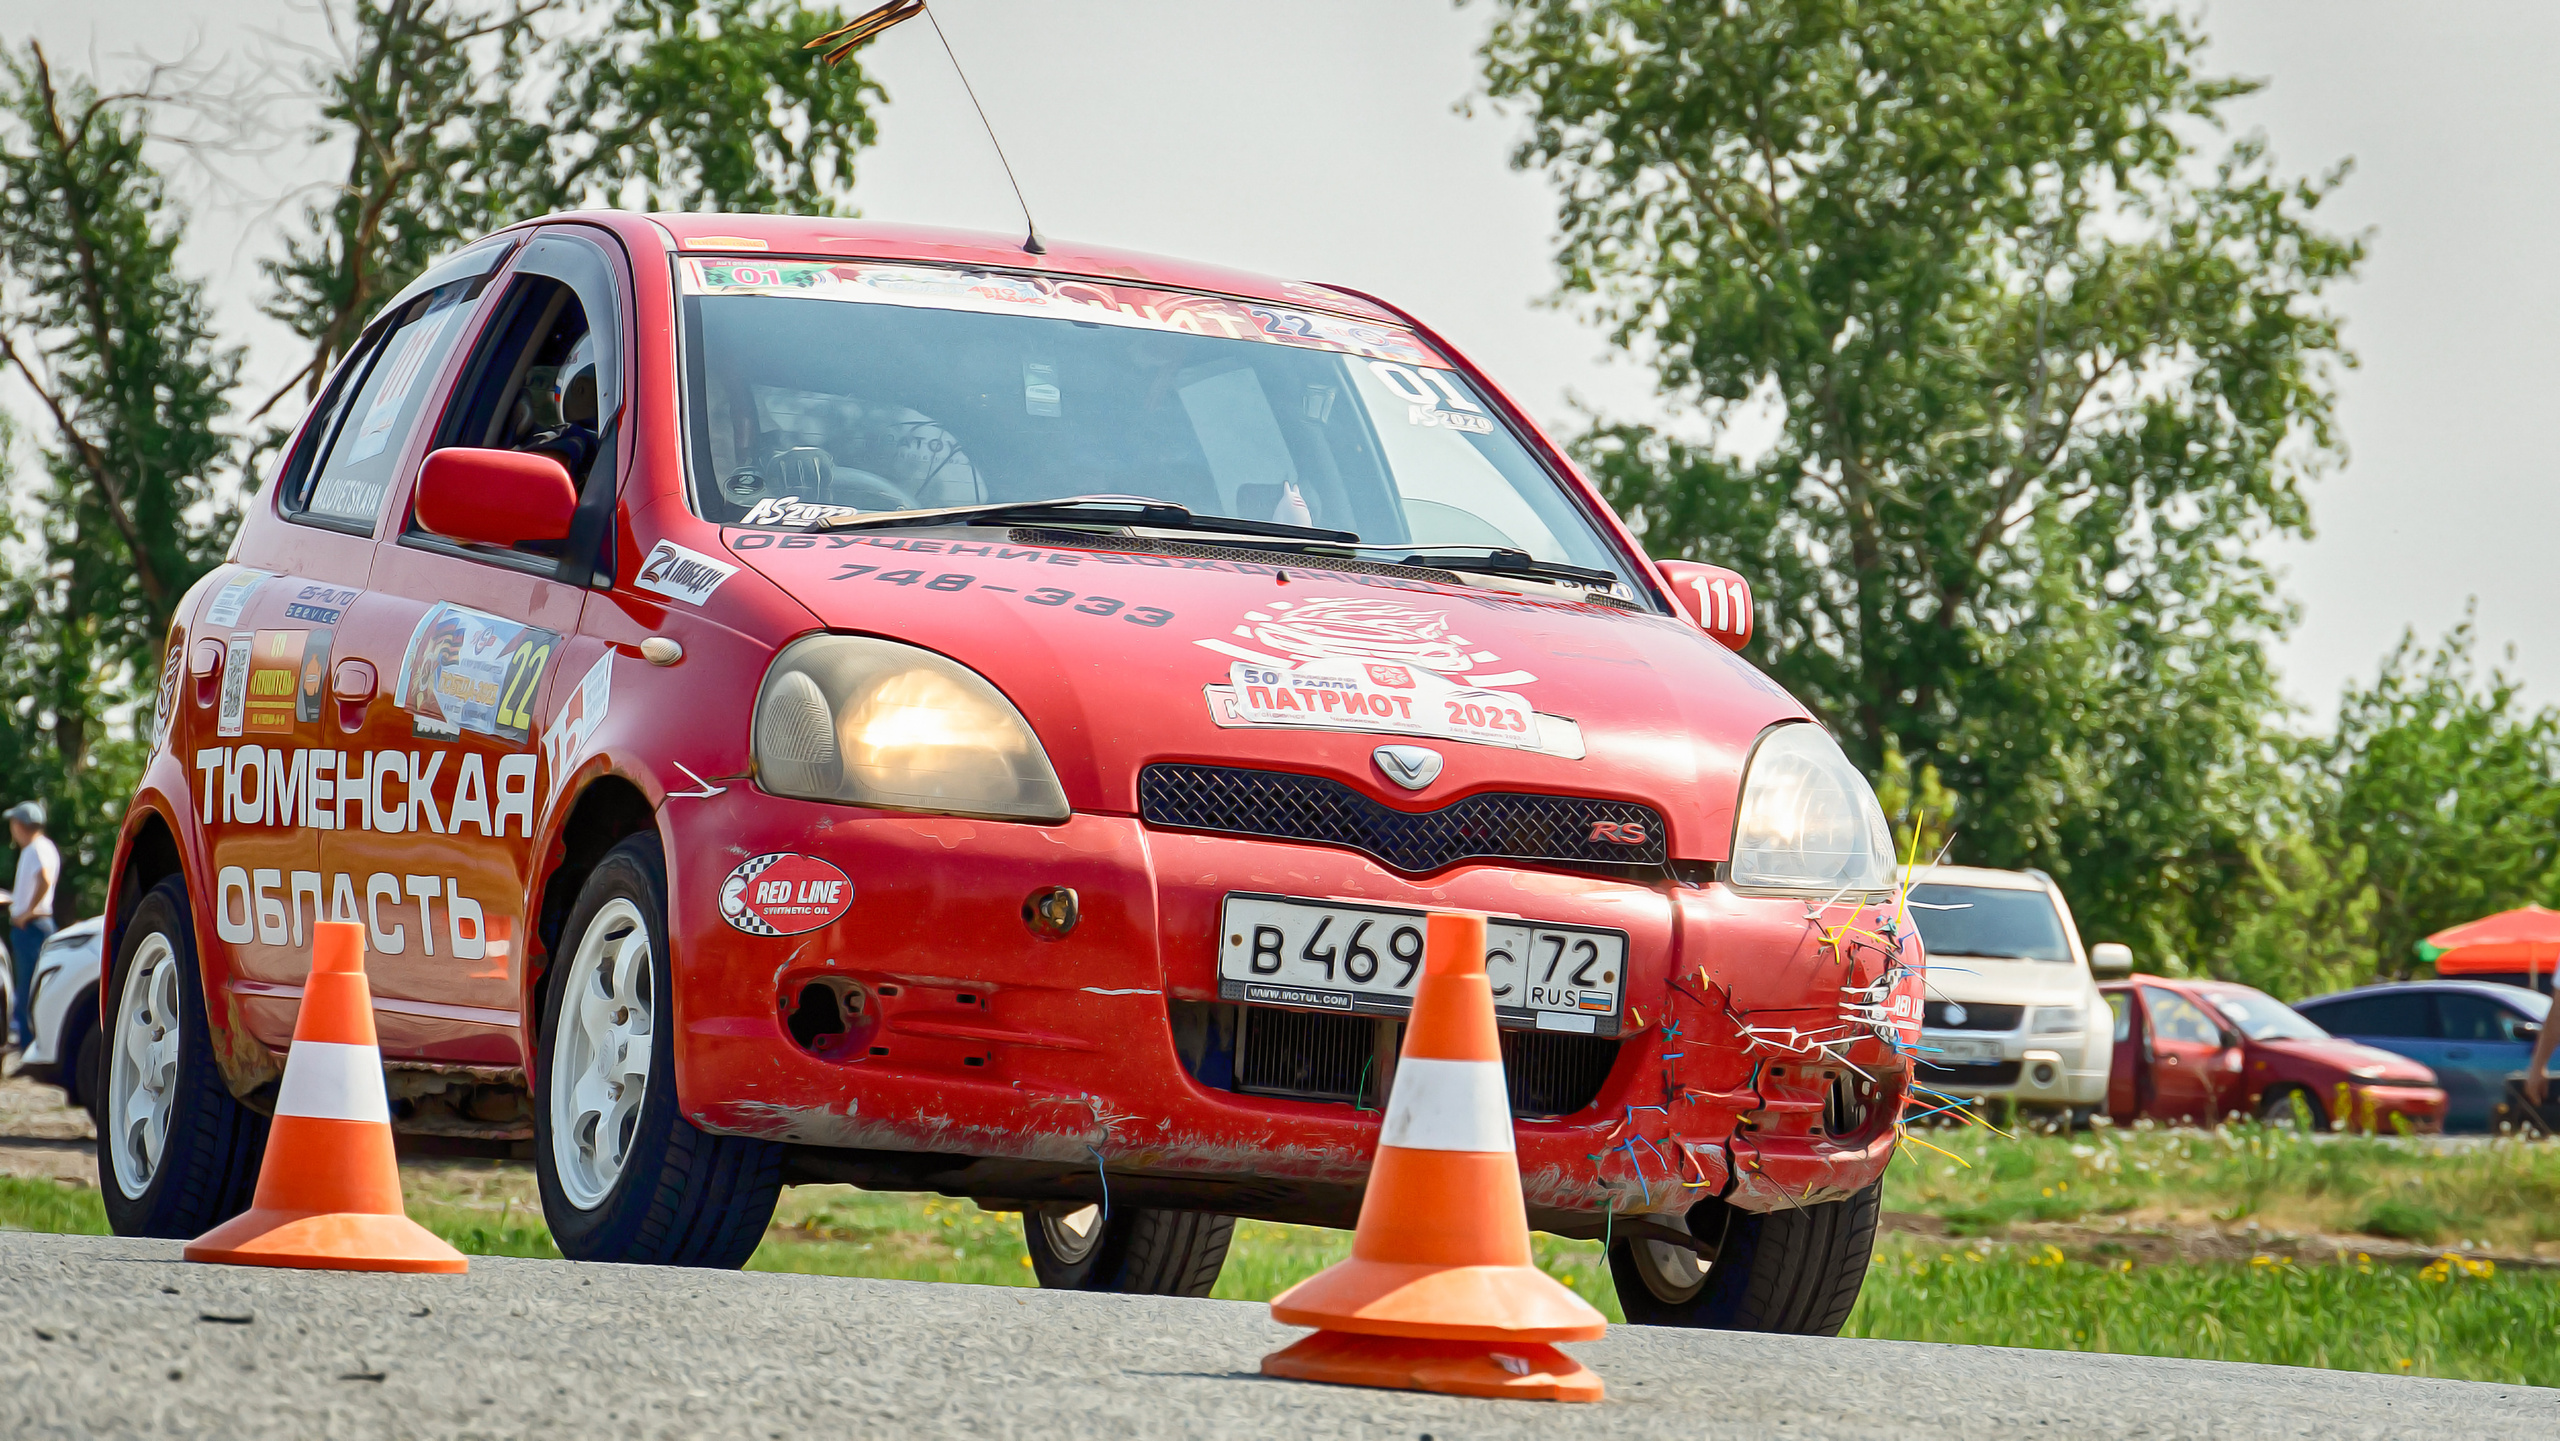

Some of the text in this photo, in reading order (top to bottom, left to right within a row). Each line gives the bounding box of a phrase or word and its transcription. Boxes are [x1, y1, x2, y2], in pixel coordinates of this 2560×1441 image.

[732, 266, 781, 286] 01
[1250, 309, 1324, 340] 22
[1367, 361, 1484, 414] 01
[732, 534, 1083, 567] ОБУЧЕНИЕ
[828, 563, 1176, 628] 748-333
[1690, 575, 1746, 636] 111
[496, 640, 551, 731] 22
[1292, 679, 1358, 690] РАЛЛИ
[1246, 685, 1413, 720] ПАТРИОТ
[1444, 701, 1527, 733] 2023
[196, 743, 538, 838] ТЮМЕНСКАЯ
[1588, 820, 1647, 845] RS
[755, 880, 843, 904] RED LINE
[216, 865, 487, 960] ОБЛАСТЬ
[763, 906, 830, 915] SYNTHETIC OIL
[1300, 915, 1425, 990] 469
[1541, 935, 1598, 988] 72
[1250, 988, 1348, 1006] WWW.MOTUL.COM
[1531, 986, 1577, 1009] RUS
